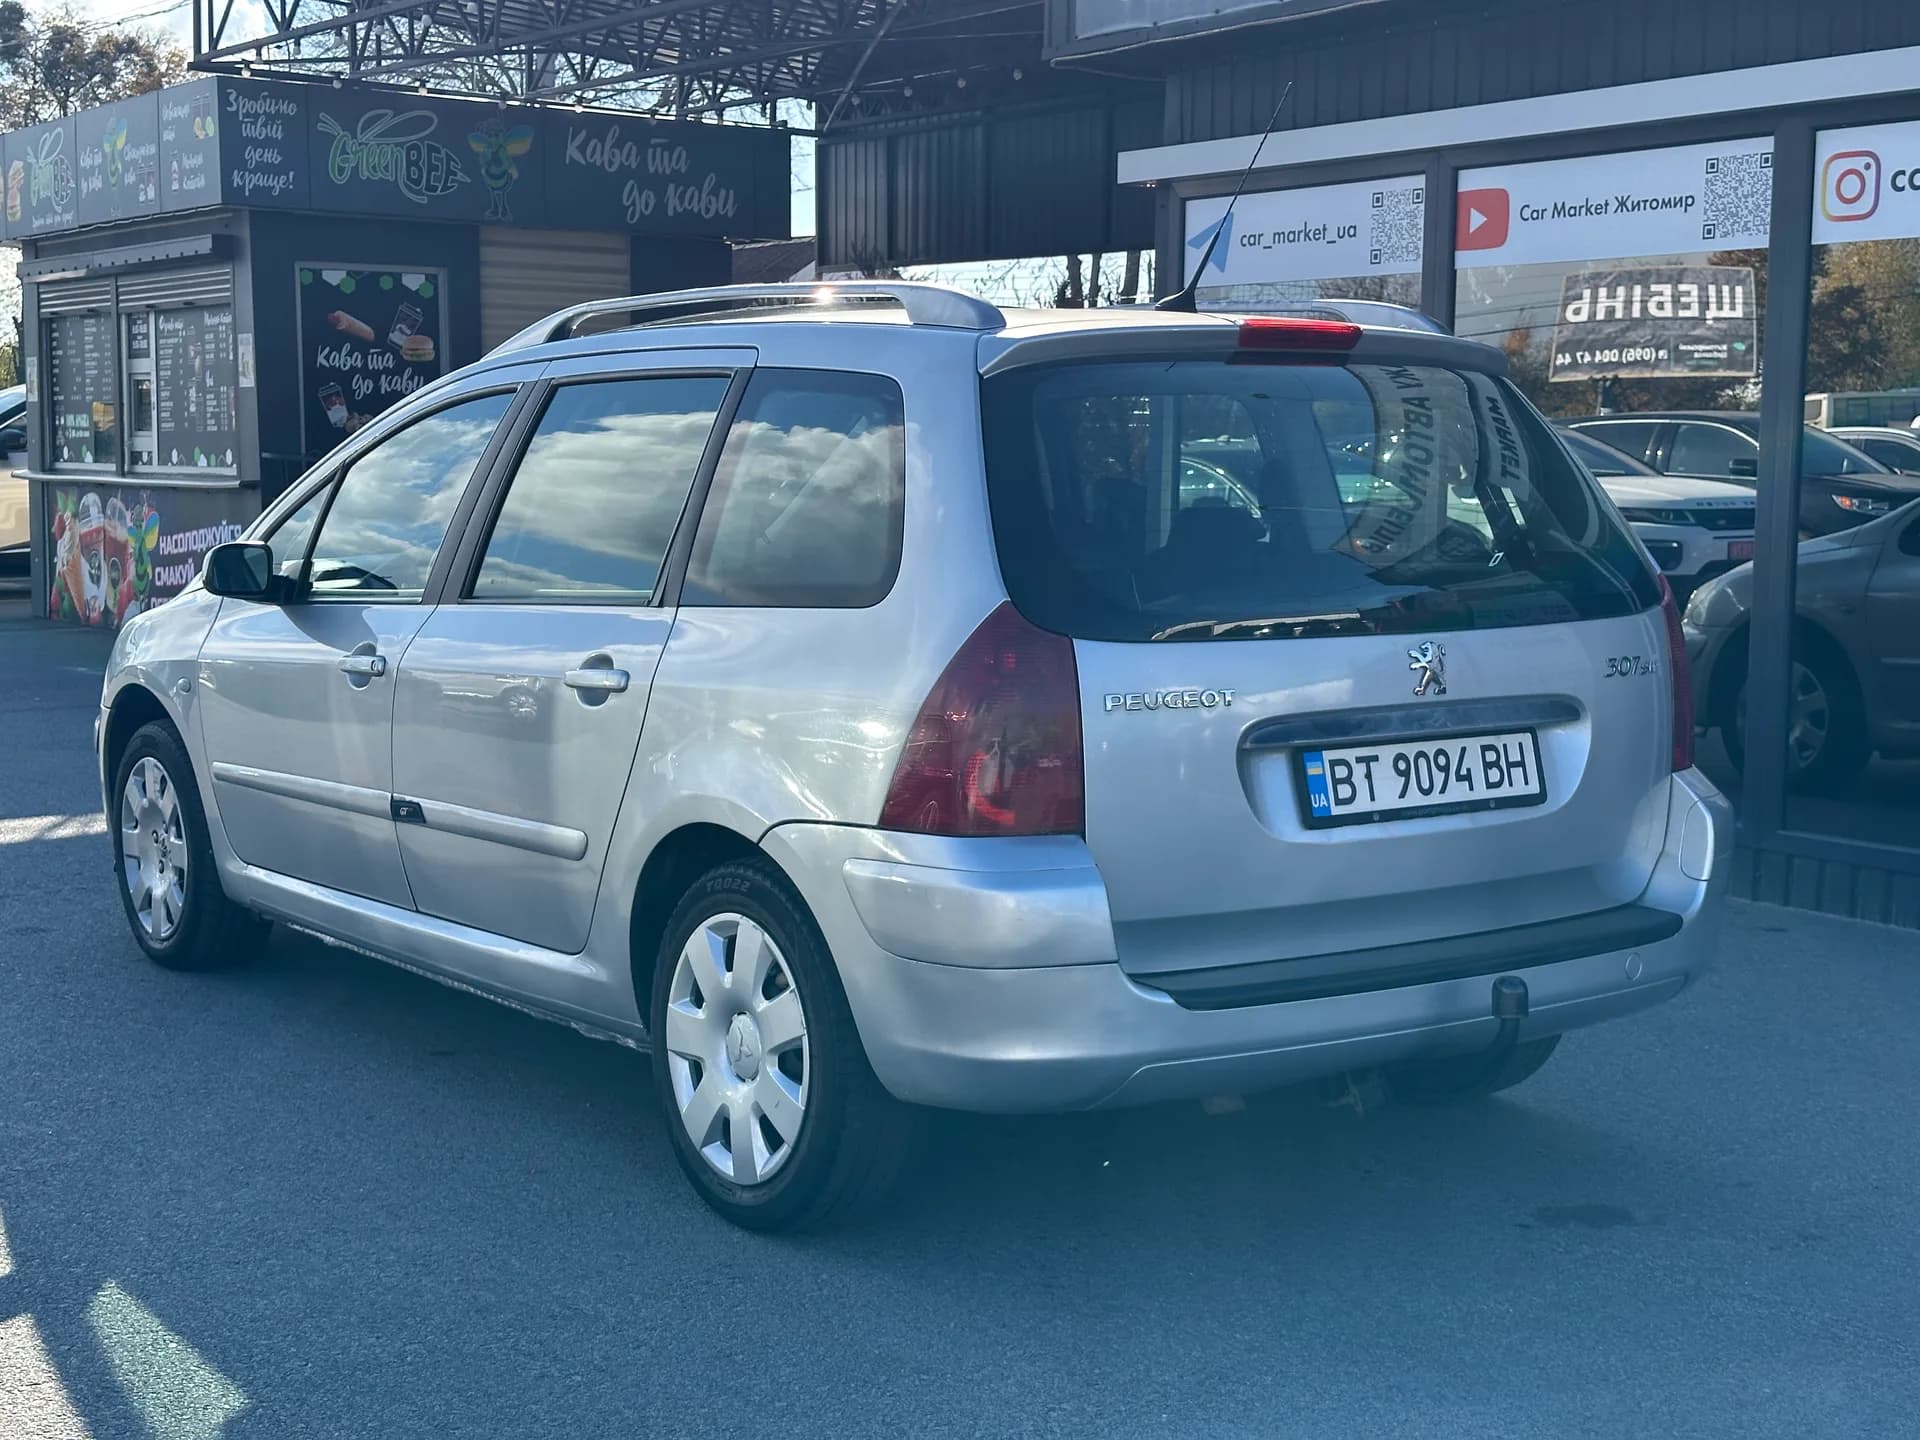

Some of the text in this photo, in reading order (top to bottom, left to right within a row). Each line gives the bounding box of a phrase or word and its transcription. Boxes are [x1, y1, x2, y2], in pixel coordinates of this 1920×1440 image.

[226, 88, 298, 120] Зробимо
[241, 115, 284, 140] твій
[245, 145, 283, 169] день
[328, 131, 472, 196] Green BEE
[565, 125, 691, 175] Кава та
[622, 173, 738, 224] до кави
[1519, 194, 1696, 221] Car Market Житомир
[1240, 221, 1358, 249] car_market_ua
[316, 342, 396, 371] Кава та
[351, 367, 424, 400] до кави
[160, 519, 242, 555] НАСОЛОДЖУЙСЯ
[154, 558, 195, 586] СМАКУЙ
[1603, 655, 1640, 678] 307
[1104, 688, 1237, 712] PEUGEOT
[1328, 741, 1530, 807] BT 9094 BH
[1311, 793, 1328, 809] UA
